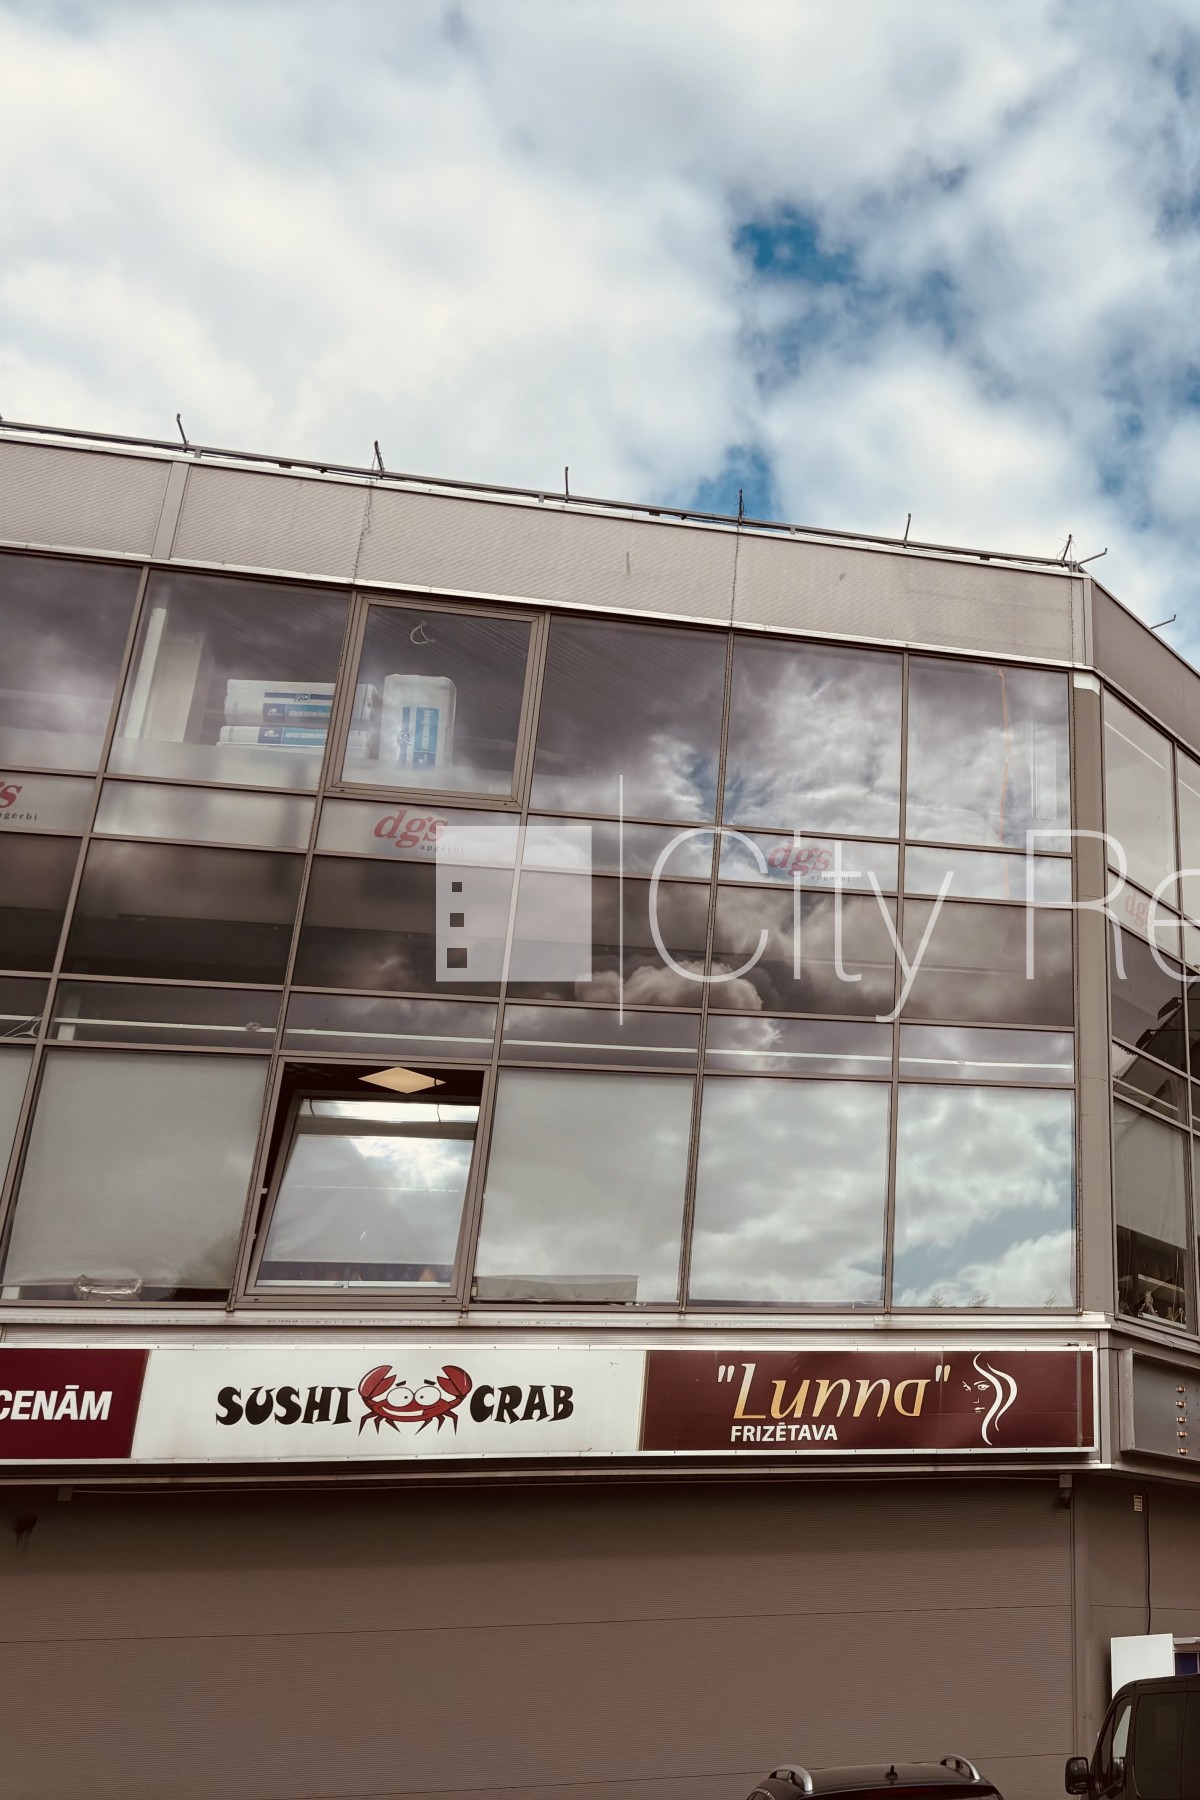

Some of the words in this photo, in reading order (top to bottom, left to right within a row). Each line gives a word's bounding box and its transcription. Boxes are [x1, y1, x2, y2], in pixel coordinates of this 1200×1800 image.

[374, 808, 449, 848] dgs
[768, 839, 833, 877] dgs
[215, 1386, 355, 1426] SUSHI
[470, 1384, 574, 1424] CRAB
[730, 1421, 838, 1442] FRIZĒTAVA
